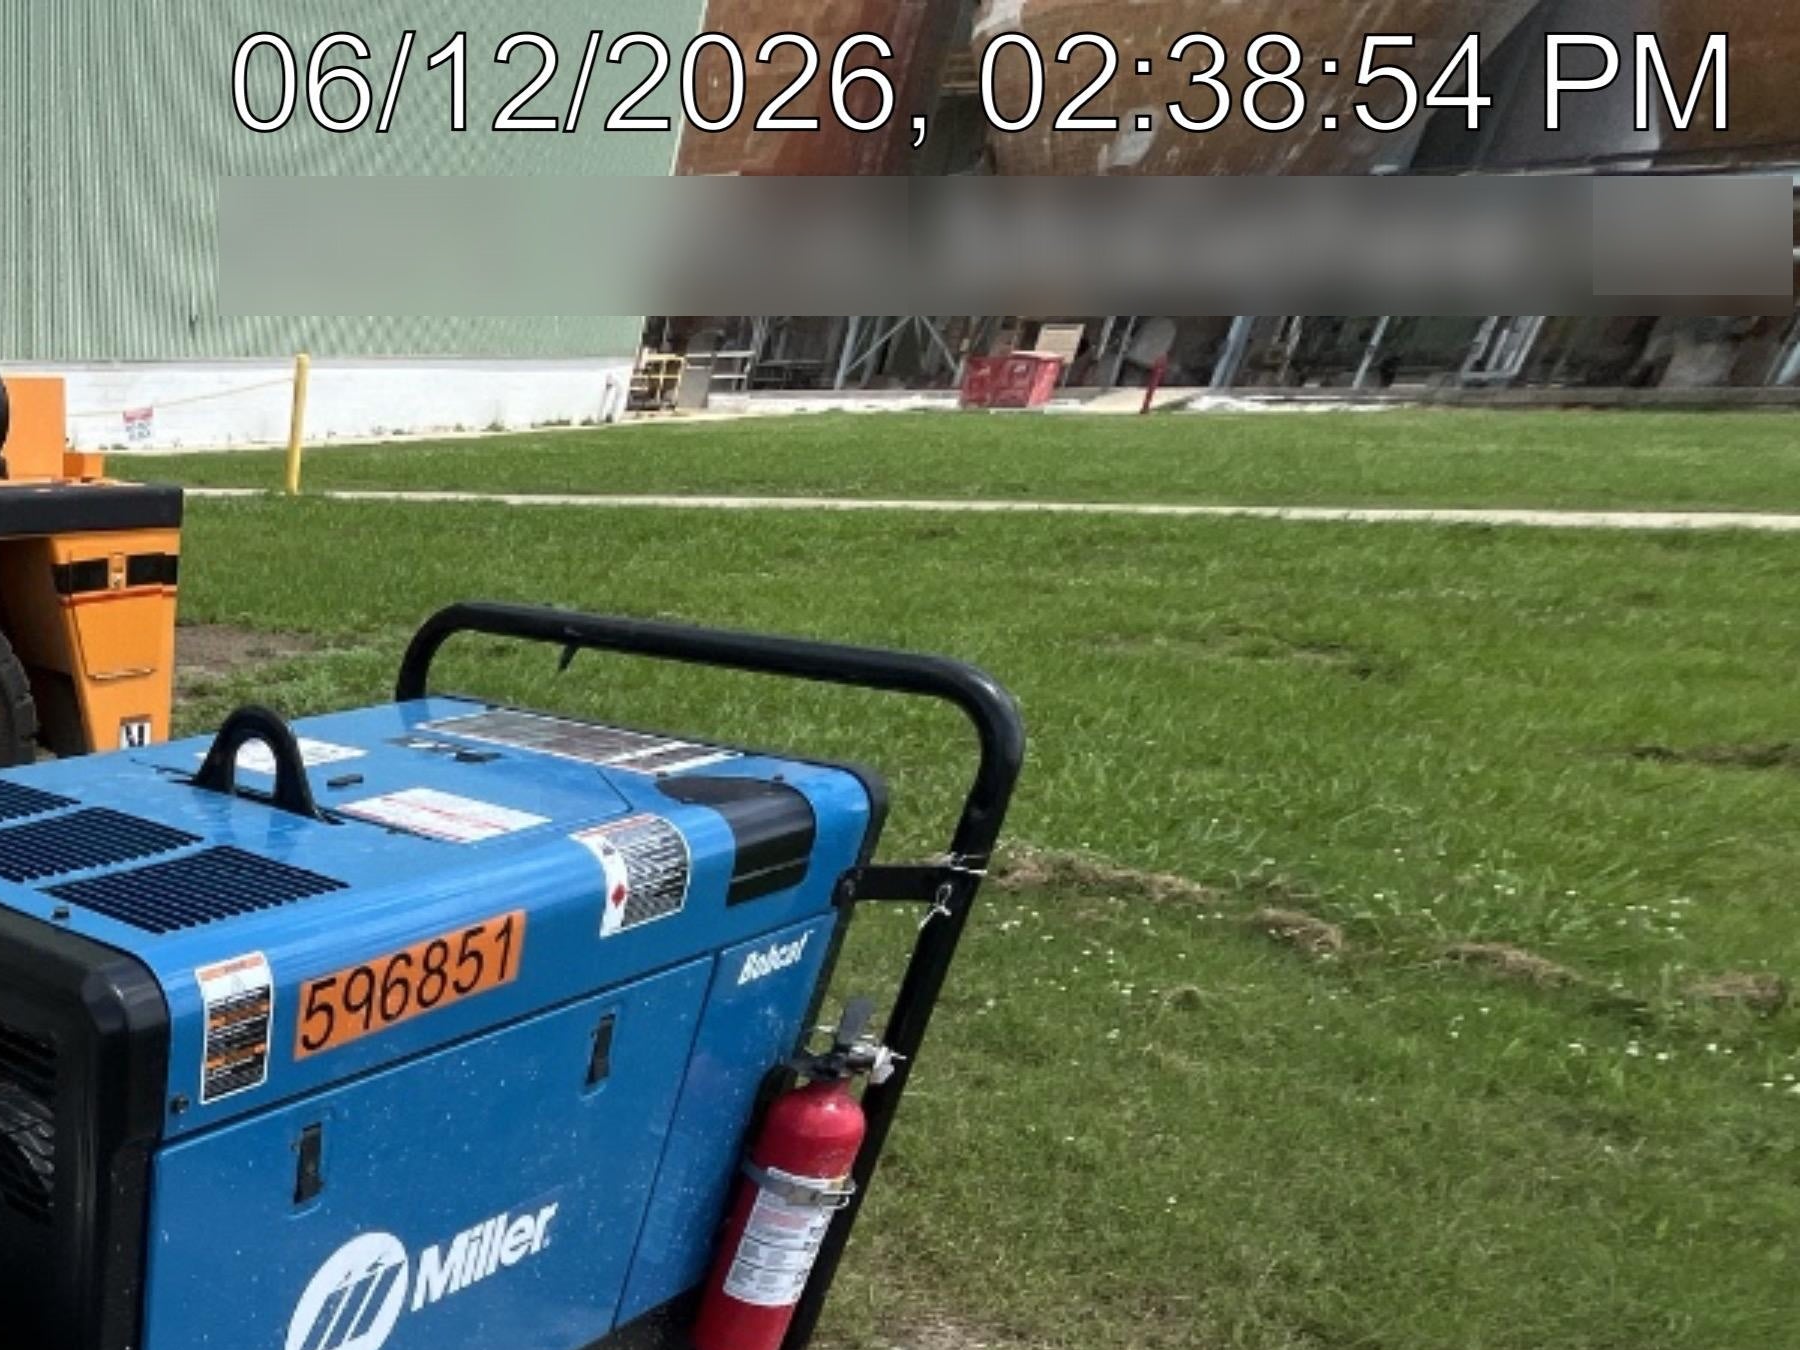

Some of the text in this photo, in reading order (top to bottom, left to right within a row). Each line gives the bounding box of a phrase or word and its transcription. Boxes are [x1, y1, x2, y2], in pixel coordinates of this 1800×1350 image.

[301, 914, 514, 1051] 596851
[737, 931, 810, 985] Bobcat
[410, 1201, 559, 1313] Miller
